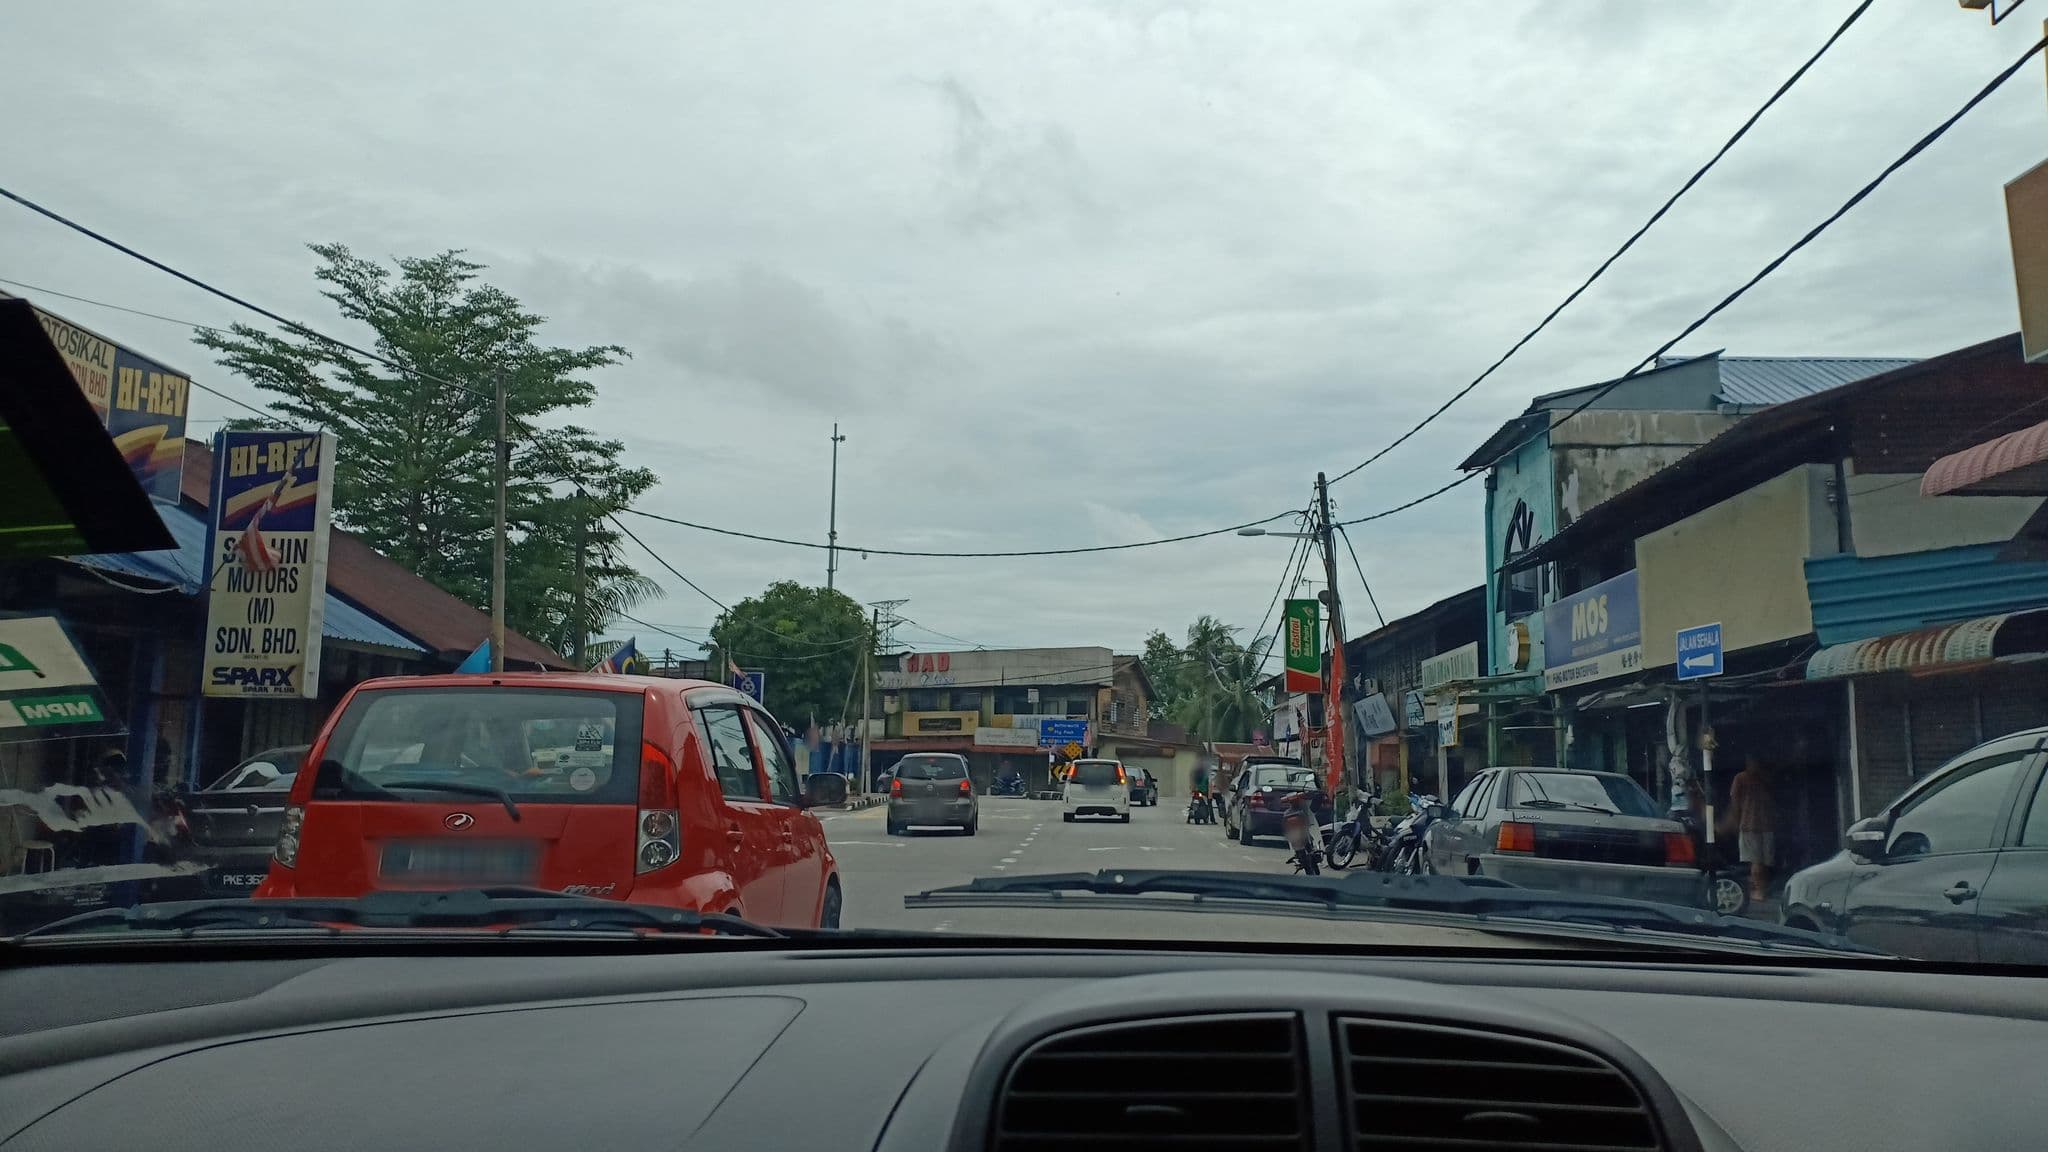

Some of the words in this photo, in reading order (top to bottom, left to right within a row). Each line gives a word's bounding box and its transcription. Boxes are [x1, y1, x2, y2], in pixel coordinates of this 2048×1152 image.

[40, 317, 108, 369] OTOSIKAL
[89, 371, 108, 399] BHD
[116, 366, 187, 416] HI-REV
[229, 437, 320, 477] HI-REV
[222, 536, 308, 565] SHIN
[227, 566, 299, 593] MOTORS
[247, 597, 275, 624] (M)
[1572, 595, 1608, 641] MOS
[215, 626, 255, 654] SDN.
[261, 627, 300, 654] BHD.
[1291, 618, 1300, 649] Castrol
[1679, 633, 1697, 651] JALAN
[1697, 630, 1720, 649] SEHALA
[211, 665, 297, 686] SPARX
[223, 874, 245, 885] PKE
